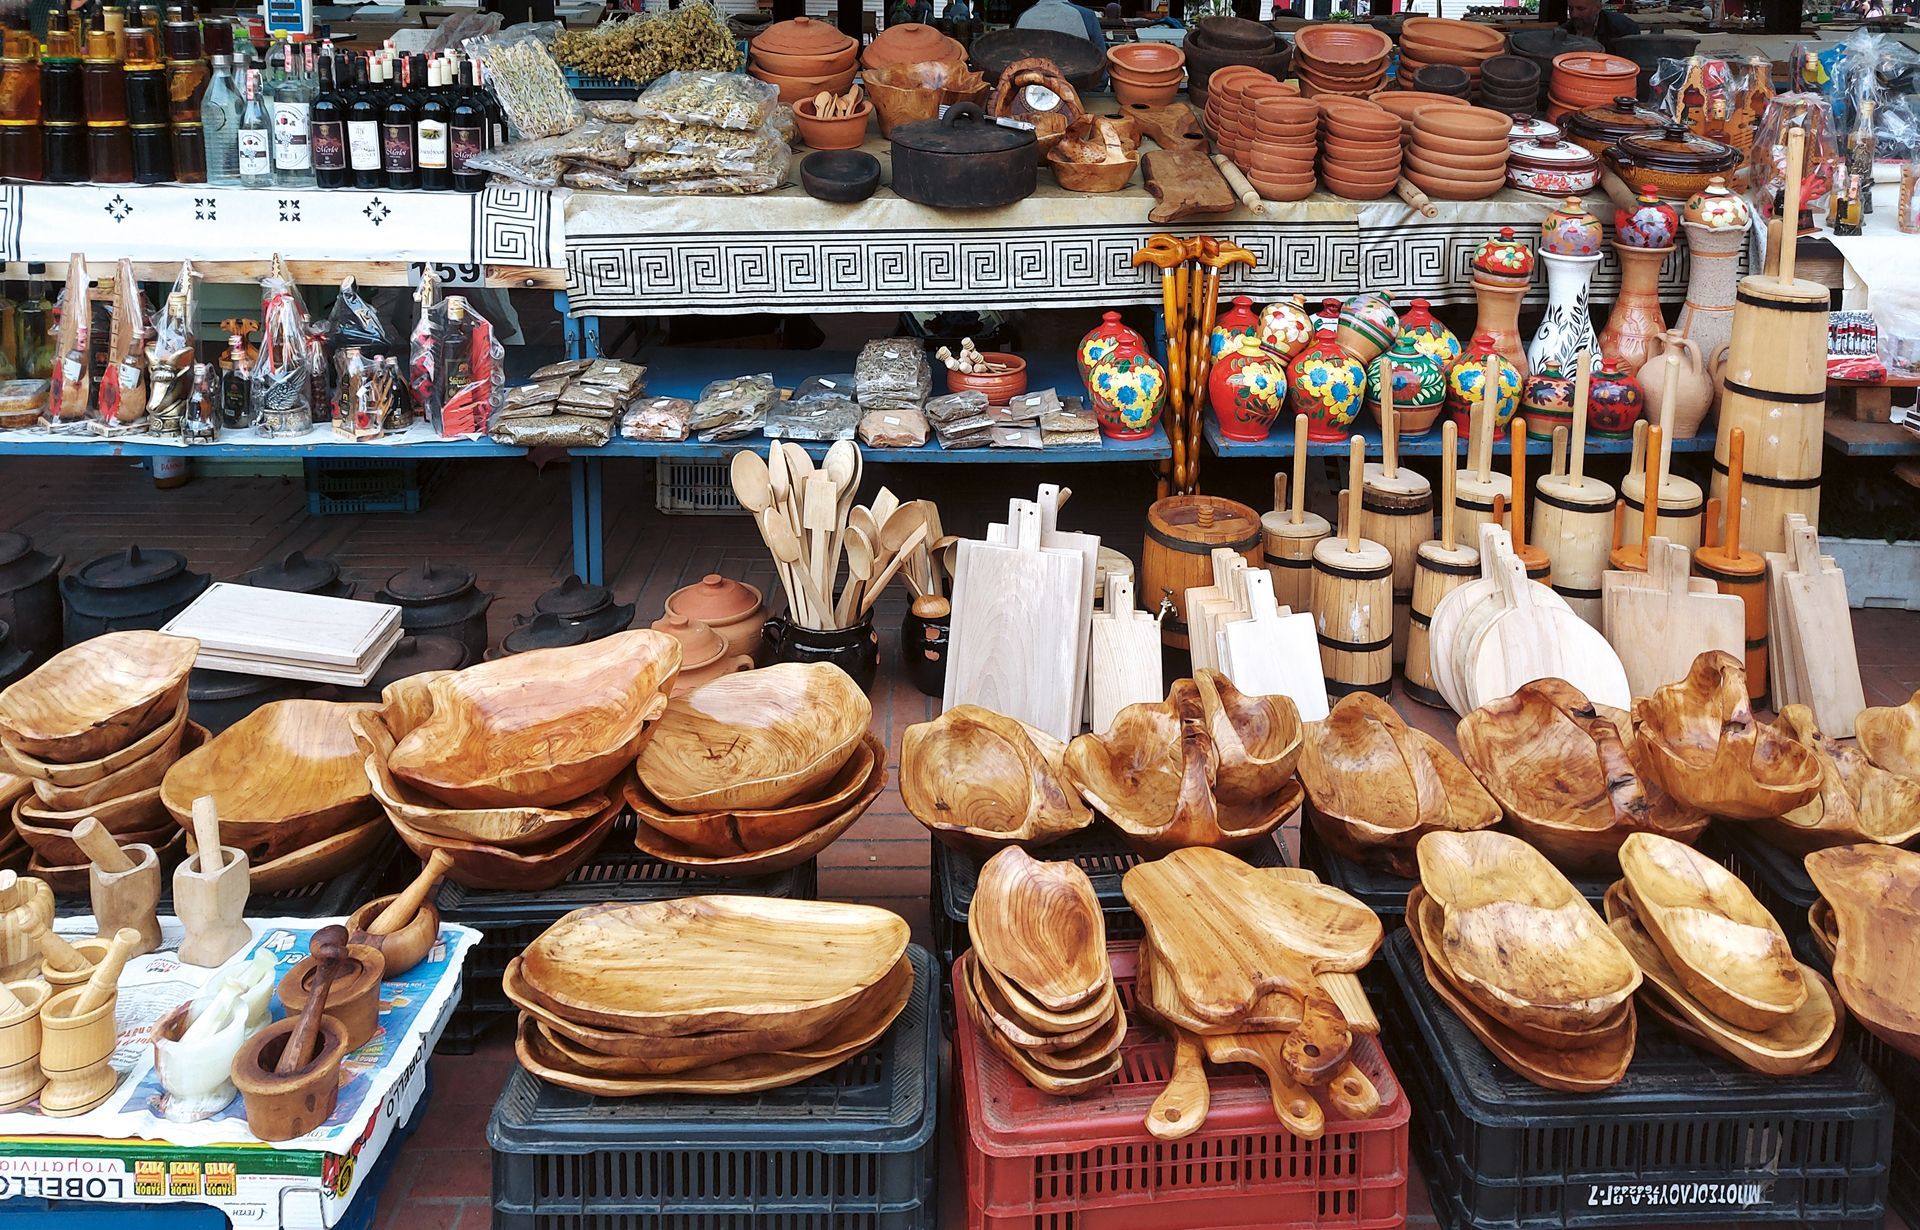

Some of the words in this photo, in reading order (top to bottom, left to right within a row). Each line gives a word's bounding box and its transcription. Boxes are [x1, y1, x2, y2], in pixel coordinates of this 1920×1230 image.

[135, 1185, 161, 1195] SABOR
[170, 1186, 196, 1195] SABOR
[206, 1186, 232, 1196] SABOR
